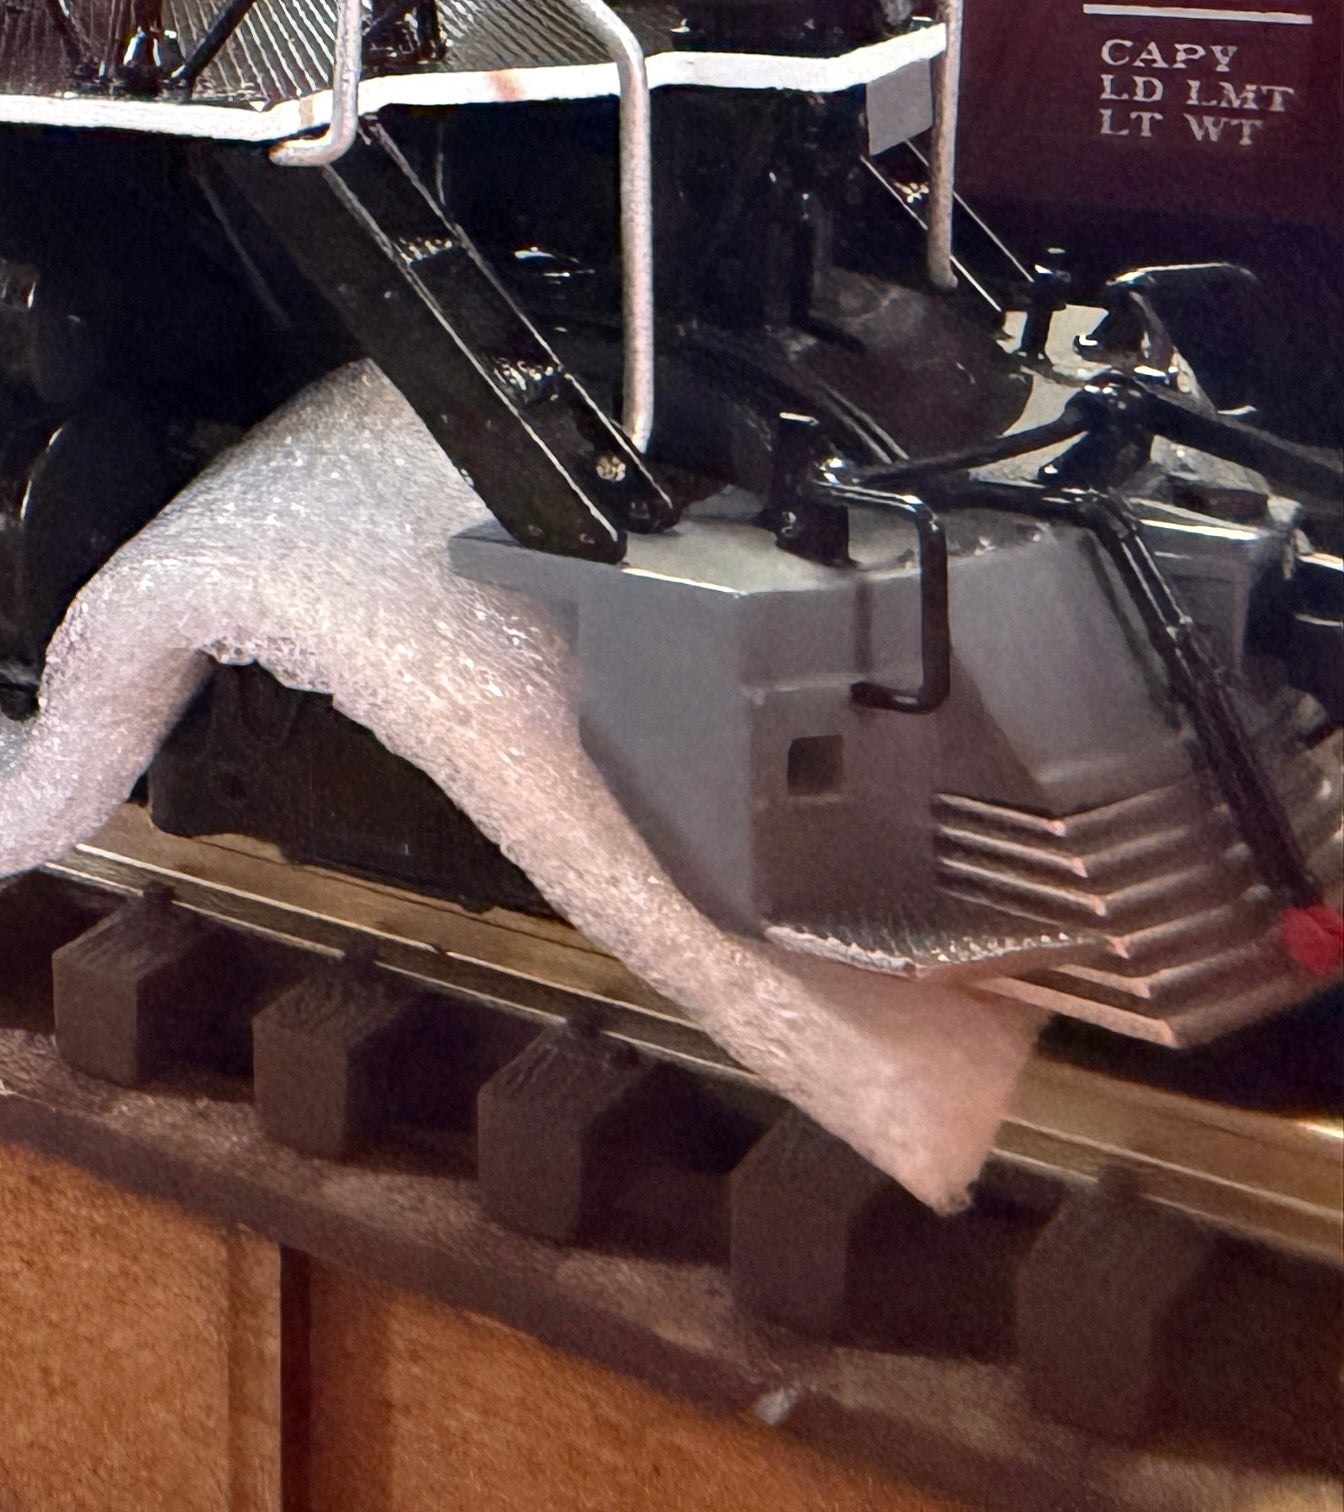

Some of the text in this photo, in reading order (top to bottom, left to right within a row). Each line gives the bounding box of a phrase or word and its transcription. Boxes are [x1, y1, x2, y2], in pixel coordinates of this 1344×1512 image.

[1101, 39, 1238, 72] CAPY
[1100, 74, 1295, 112] LD LMT
[1099, 108, 1263, 145] LT WT
